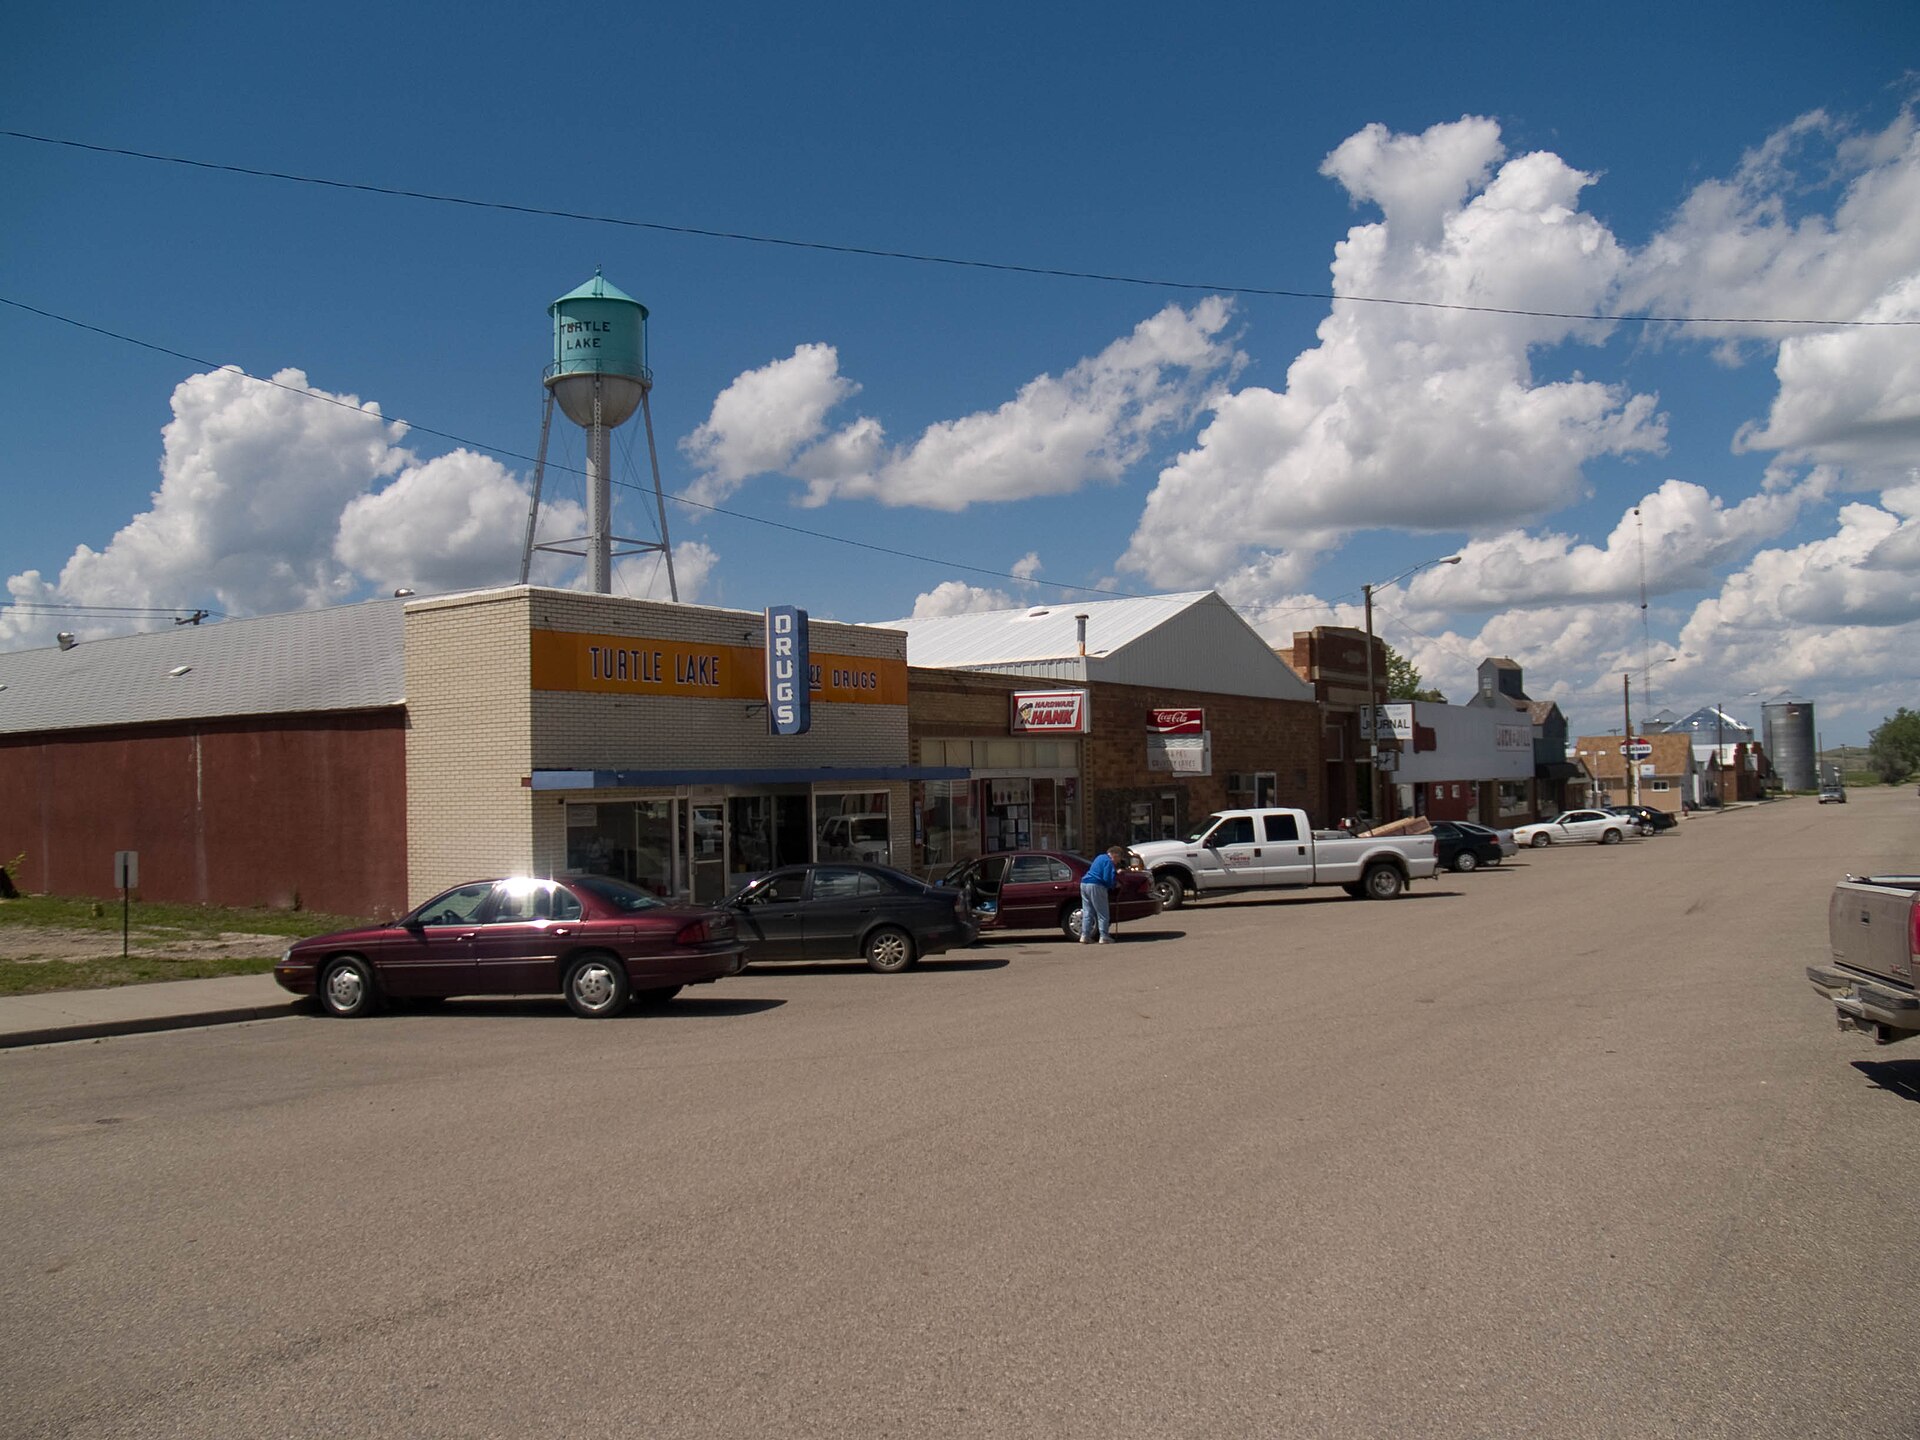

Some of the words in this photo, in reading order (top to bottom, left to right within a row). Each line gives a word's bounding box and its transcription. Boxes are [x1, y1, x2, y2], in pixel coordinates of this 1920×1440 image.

[560, 321, 611, 334] TURTLE
[567, 338, 601, 350] LAKE
[589, 647, 663, 683] TURTLE
[675, 653, 720, 687] LAKE
[832, 669, 877, 689] DRUGS
[774, 614, 794, 724] DRUGS
[1034, 700, 1075, 708] HARDWARE
[1031, 710, 1075, 725] HANK
[1362, 707, 1383, 717] TE
